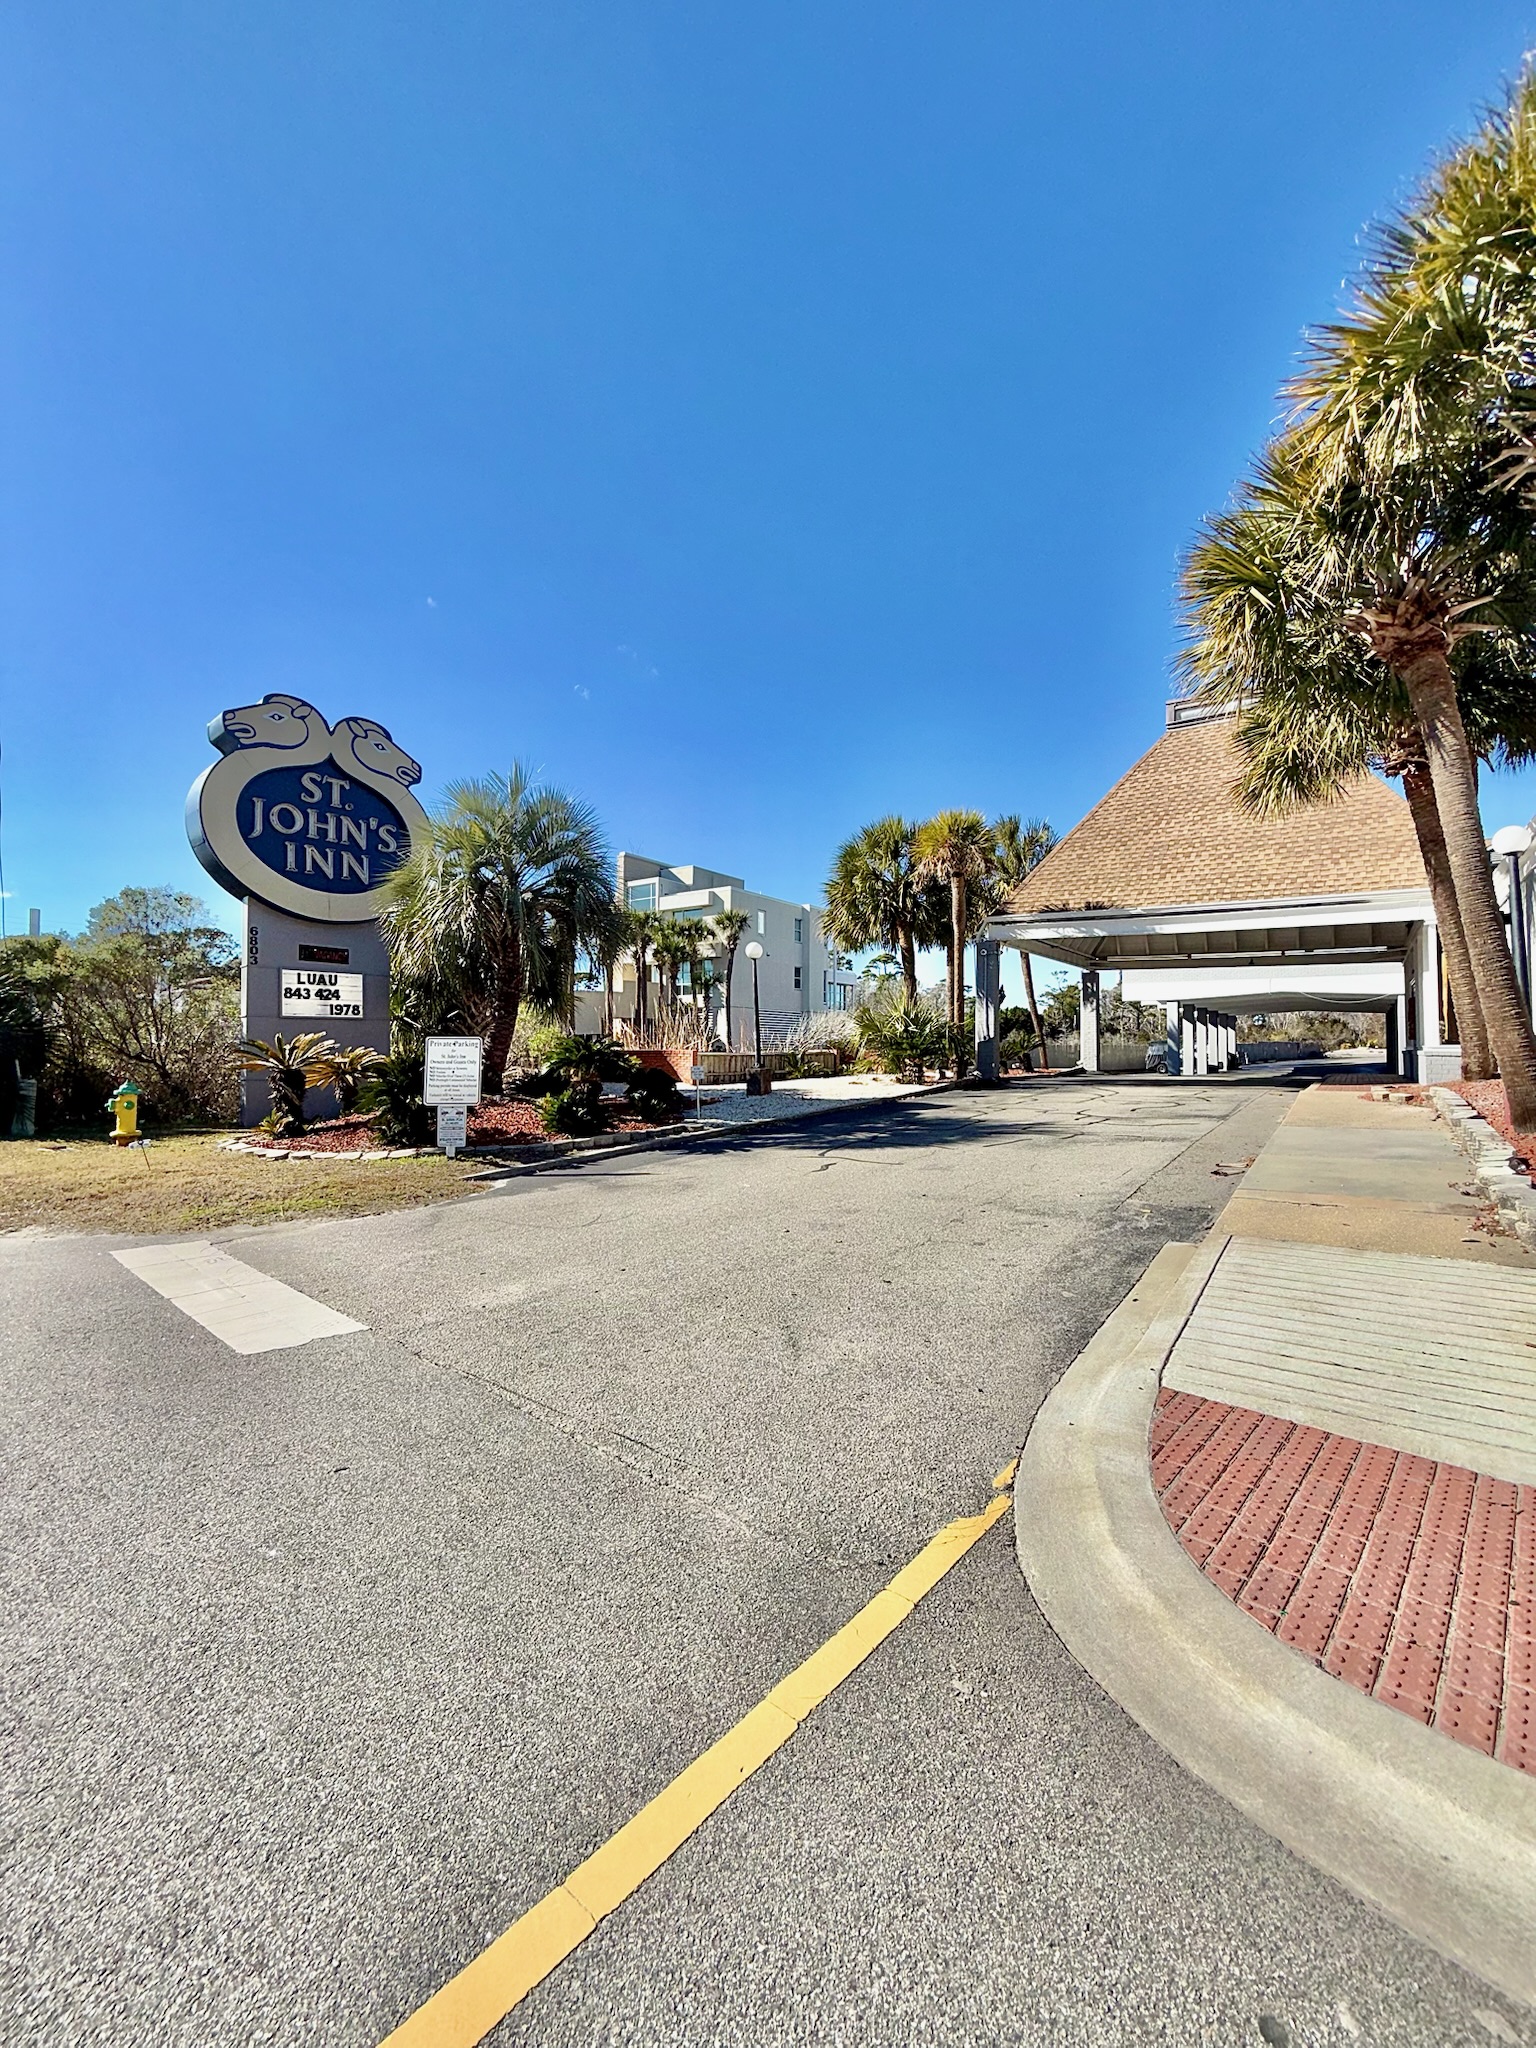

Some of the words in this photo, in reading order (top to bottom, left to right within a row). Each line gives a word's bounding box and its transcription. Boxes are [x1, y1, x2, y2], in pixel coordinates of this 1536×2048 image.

[301, 771, 353, 810] ST.
[248, 797, 397, 853] JOHN'S
[285, 841, 370, 885] INN
[249, 927, 259, 965] 6803
[297, 973, 338, 986] LUAU
[284, 987, 311, 999] 843
[314, 988, 341, 1000] 424
[329, 1004, 361, 1016] 1978
[454, 1040, 479, 1048] Parking
